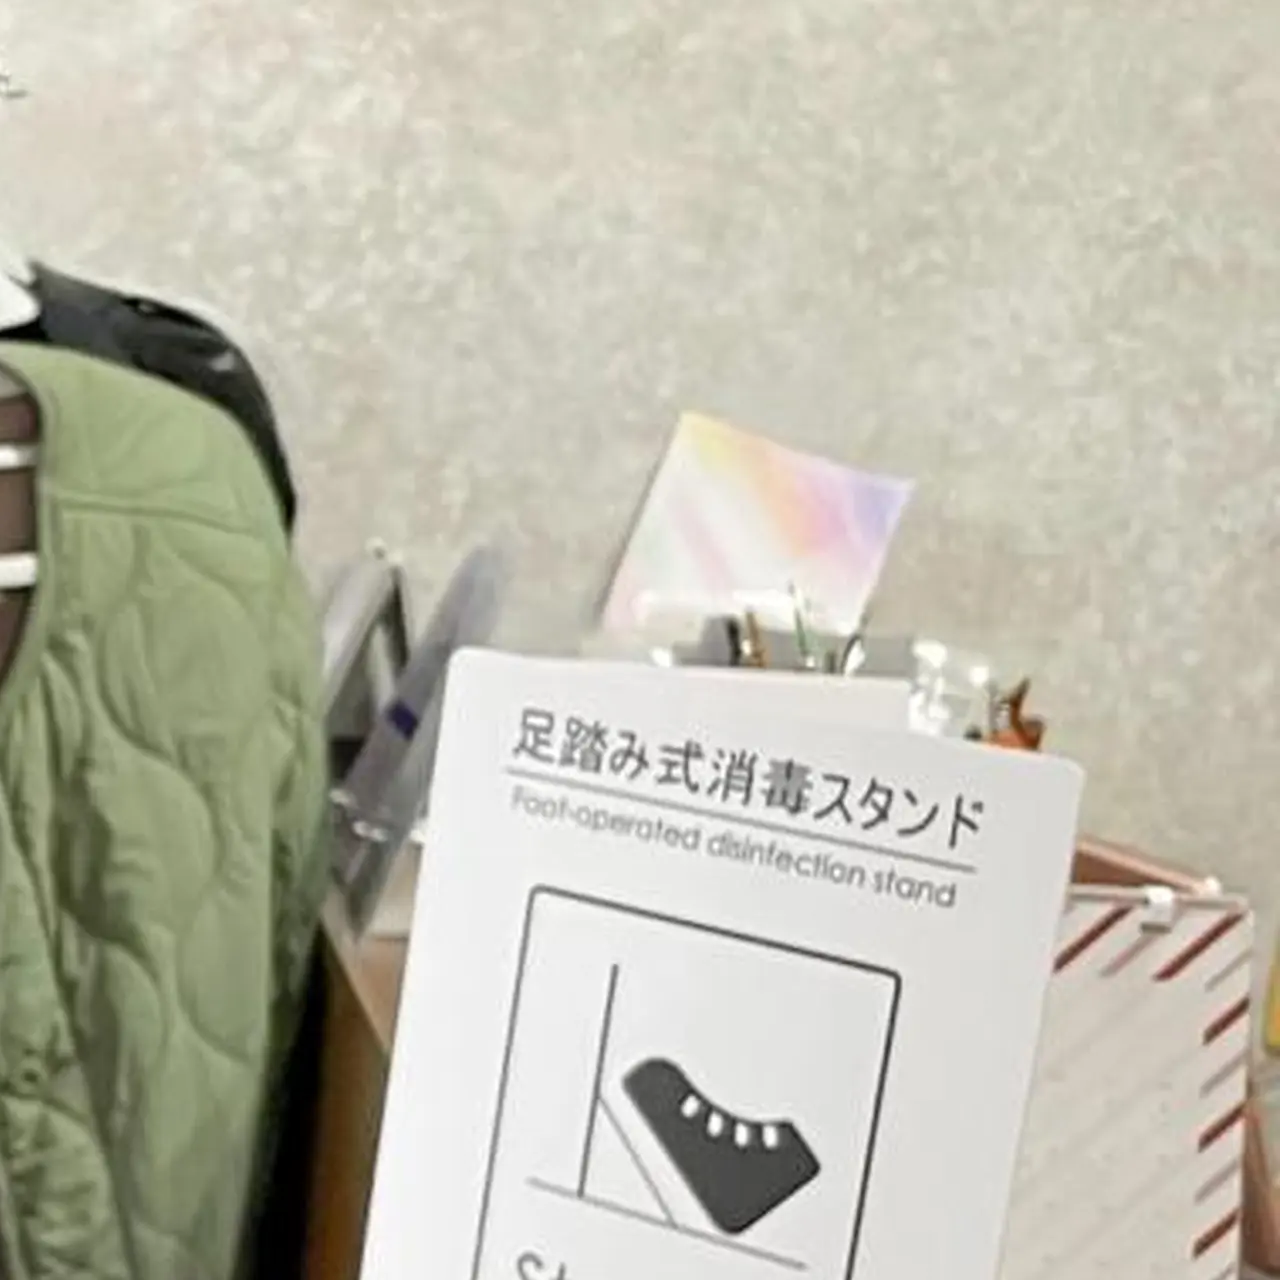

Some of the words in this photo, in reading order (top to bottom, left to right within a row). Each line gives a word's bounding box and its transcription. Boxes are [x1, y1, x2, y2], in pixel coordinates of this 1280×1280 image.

[512, 706, 985, 850] 足踏み式消毒スタンド
[512, 783, 702, 851] Foot-operated
[706, 830, 867, 888] disinfection
[873, 867, 957, 910] stand
